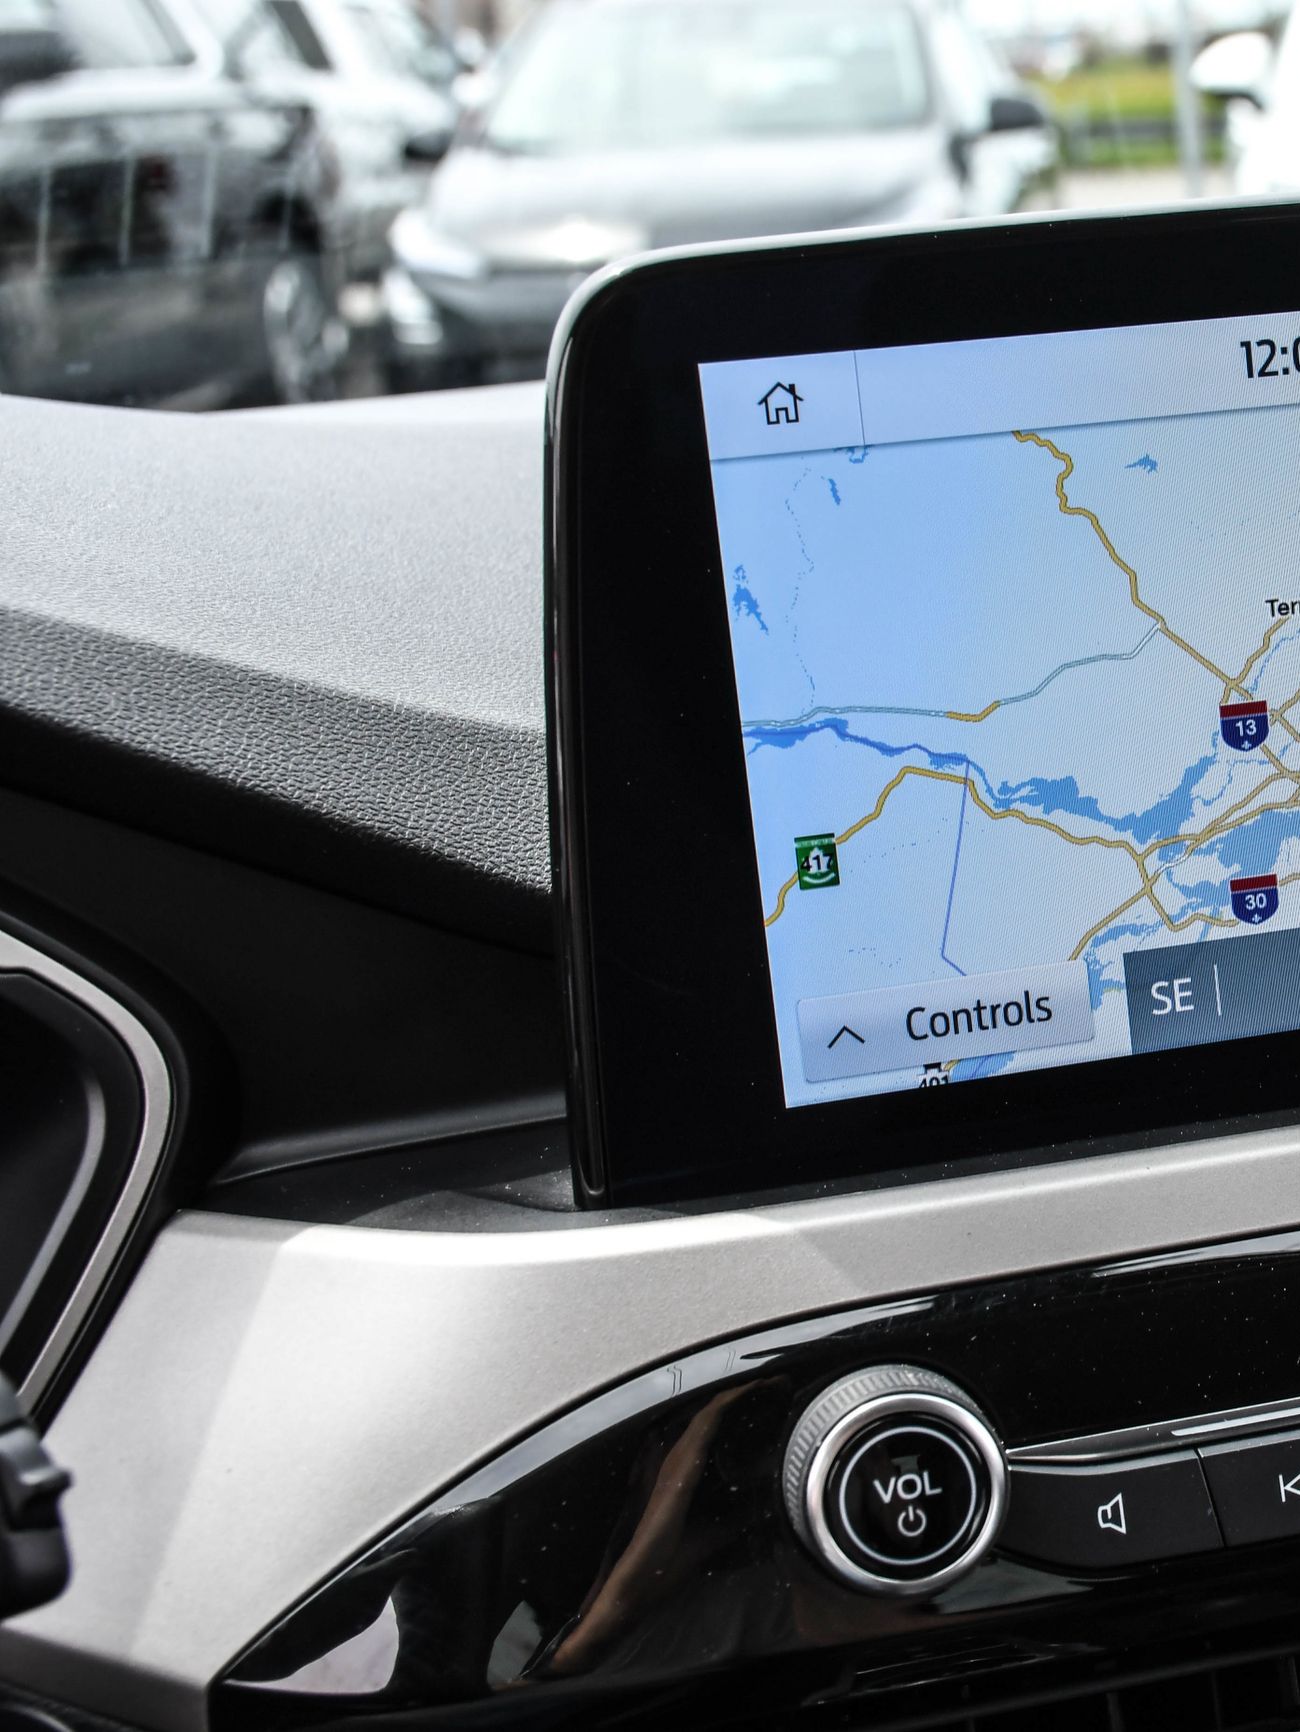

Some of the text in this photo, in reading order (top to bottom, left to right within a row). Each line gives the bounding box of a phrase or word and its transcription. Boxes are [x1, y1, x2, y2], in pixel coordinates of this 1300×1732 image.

[1235, 719, 1257, 737] 13
[800, 852, 834, 872] 417
[1244, 892, 1268, 911] 30
[1150, 977, 1195, 1016] SE
[905, 989, 1053, 1041] Controls
[873, 1470, 943, 1504] VOL
